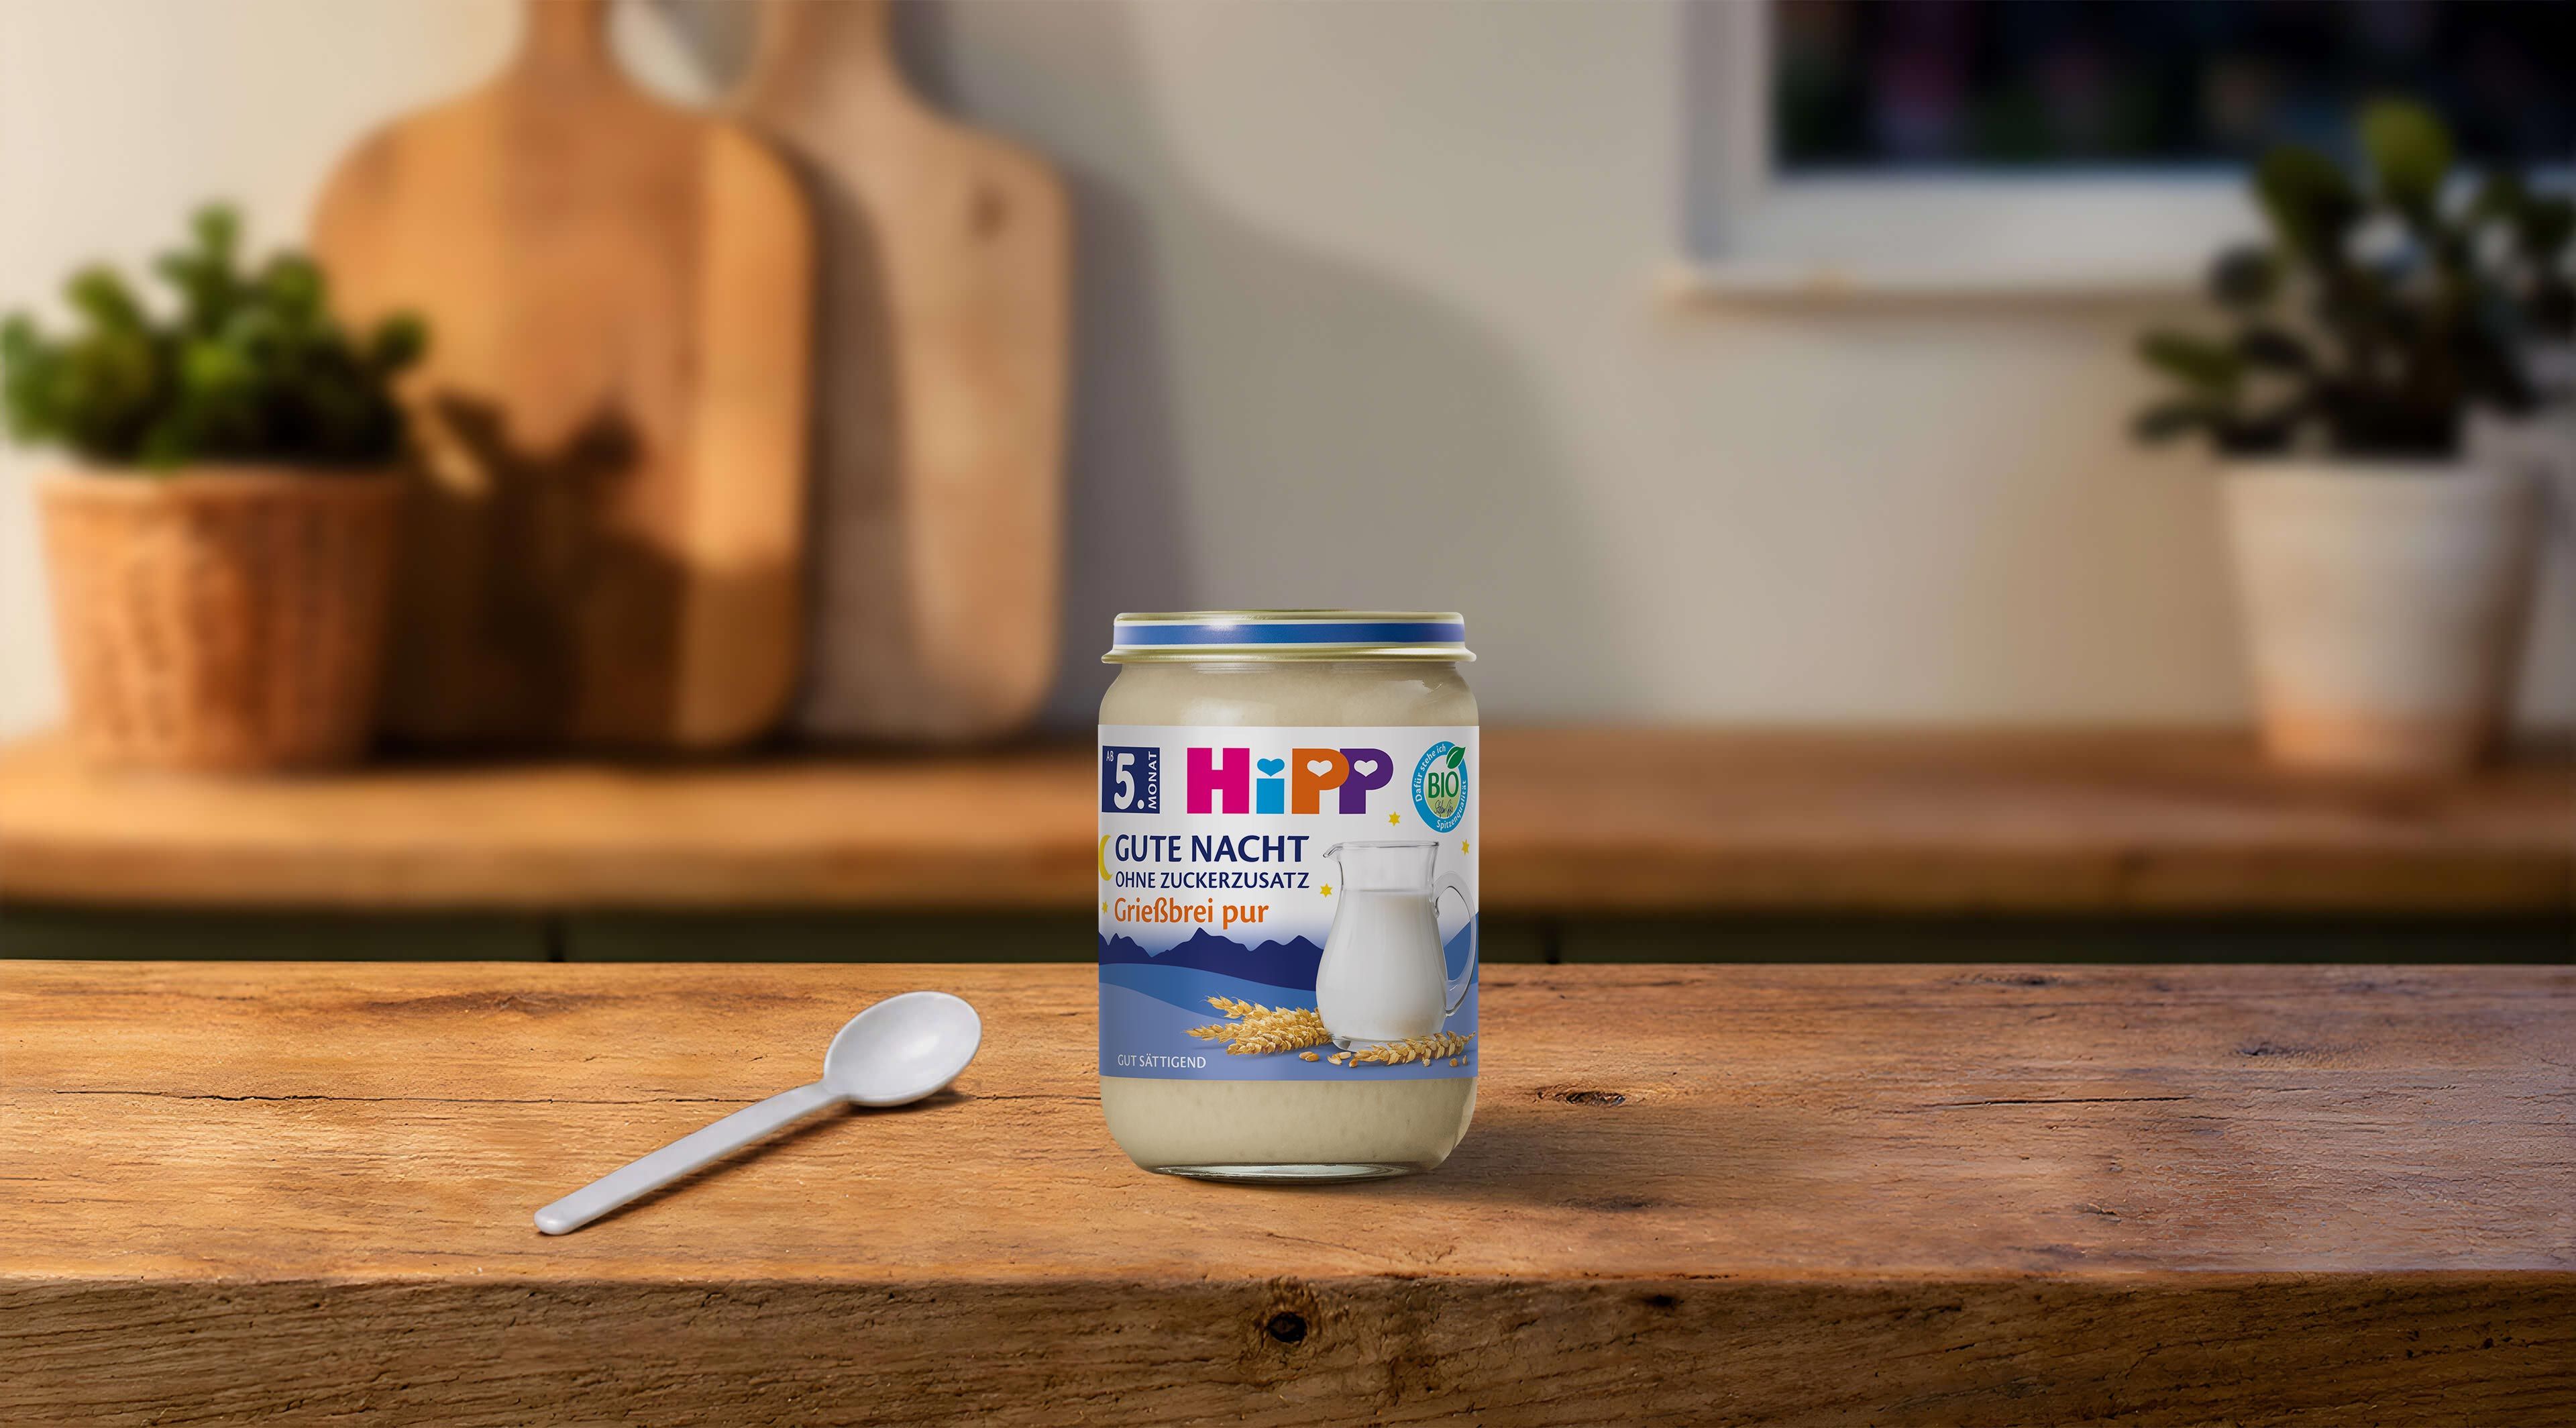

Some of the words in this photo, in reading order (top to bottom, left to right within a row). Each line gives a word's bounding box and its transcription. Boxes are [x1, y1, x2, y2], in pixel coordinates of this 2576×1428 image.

[1106, 750, 1114, 762] AB
[1114, 753, 1144, 810] 5.
[1148, 751, 1157, 809] MONAT
[1187, 748, 1394, 814] HiPP
[1413, 772, 1423, 802] Dafür
[1420, 750, 1436, 772] stehe
[1436, 743, 1446, 754] ich
[1428, 770, 1459, 799] BIO
[1115, 834, 1182, 862] GUTE
[1191, 835, 1309, 862] NACHT
[1115, 870, 1156, 888] OHNE
[1160, 872, 1309, 889] ZUCKERZUSATZ
[1114, 897, 1213, 923] Grießbrei
[1222, 905, 1269, 930] pur
[1118, 1054, 1137, 1066] GUT
[1139, 1053, 1206, 1068] SÄTTIGEND
